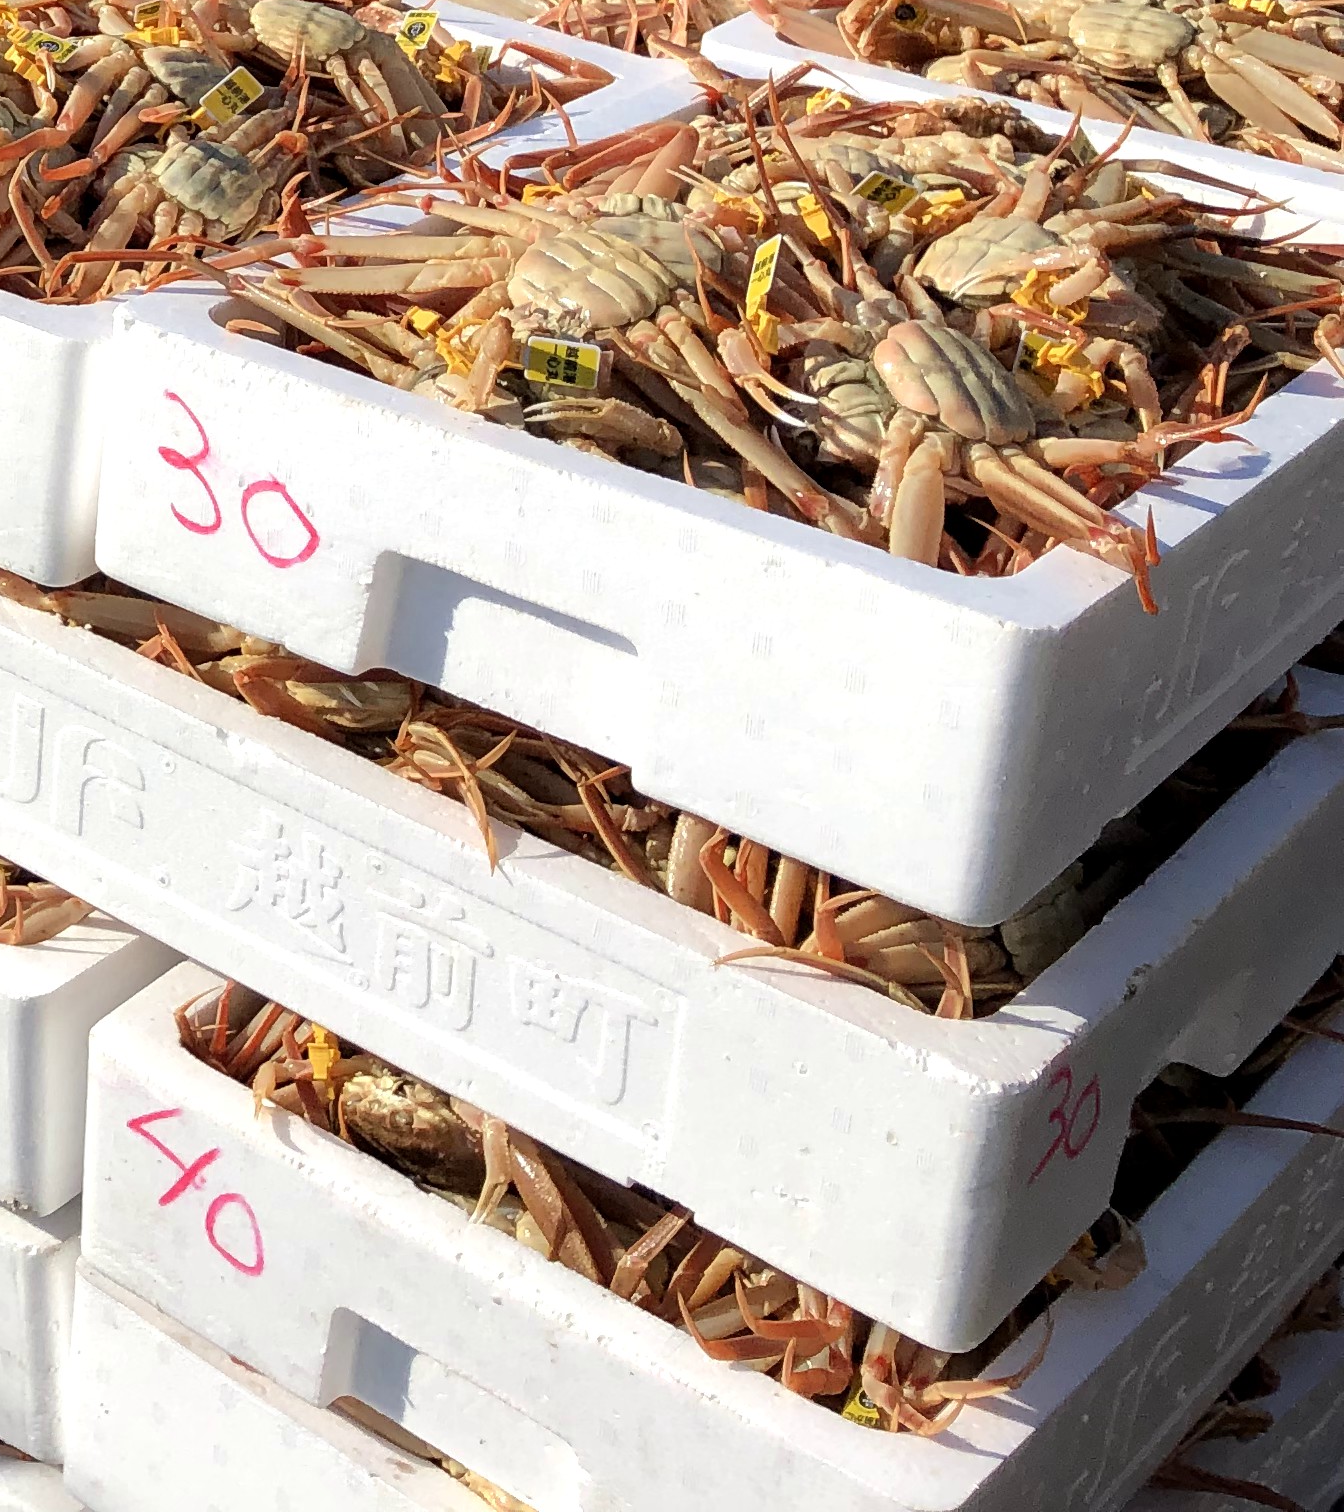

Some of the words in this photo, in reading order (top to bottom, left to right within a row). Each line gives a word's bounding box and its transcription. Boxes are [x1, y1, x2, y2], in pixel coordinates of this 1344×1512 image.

[157, 389, 322, 570] 30
[228, 814, 660, 1108] 越前町
[126, 1107, 266, 1278] 40
[1028, 1063, 1102, 1185] 30
